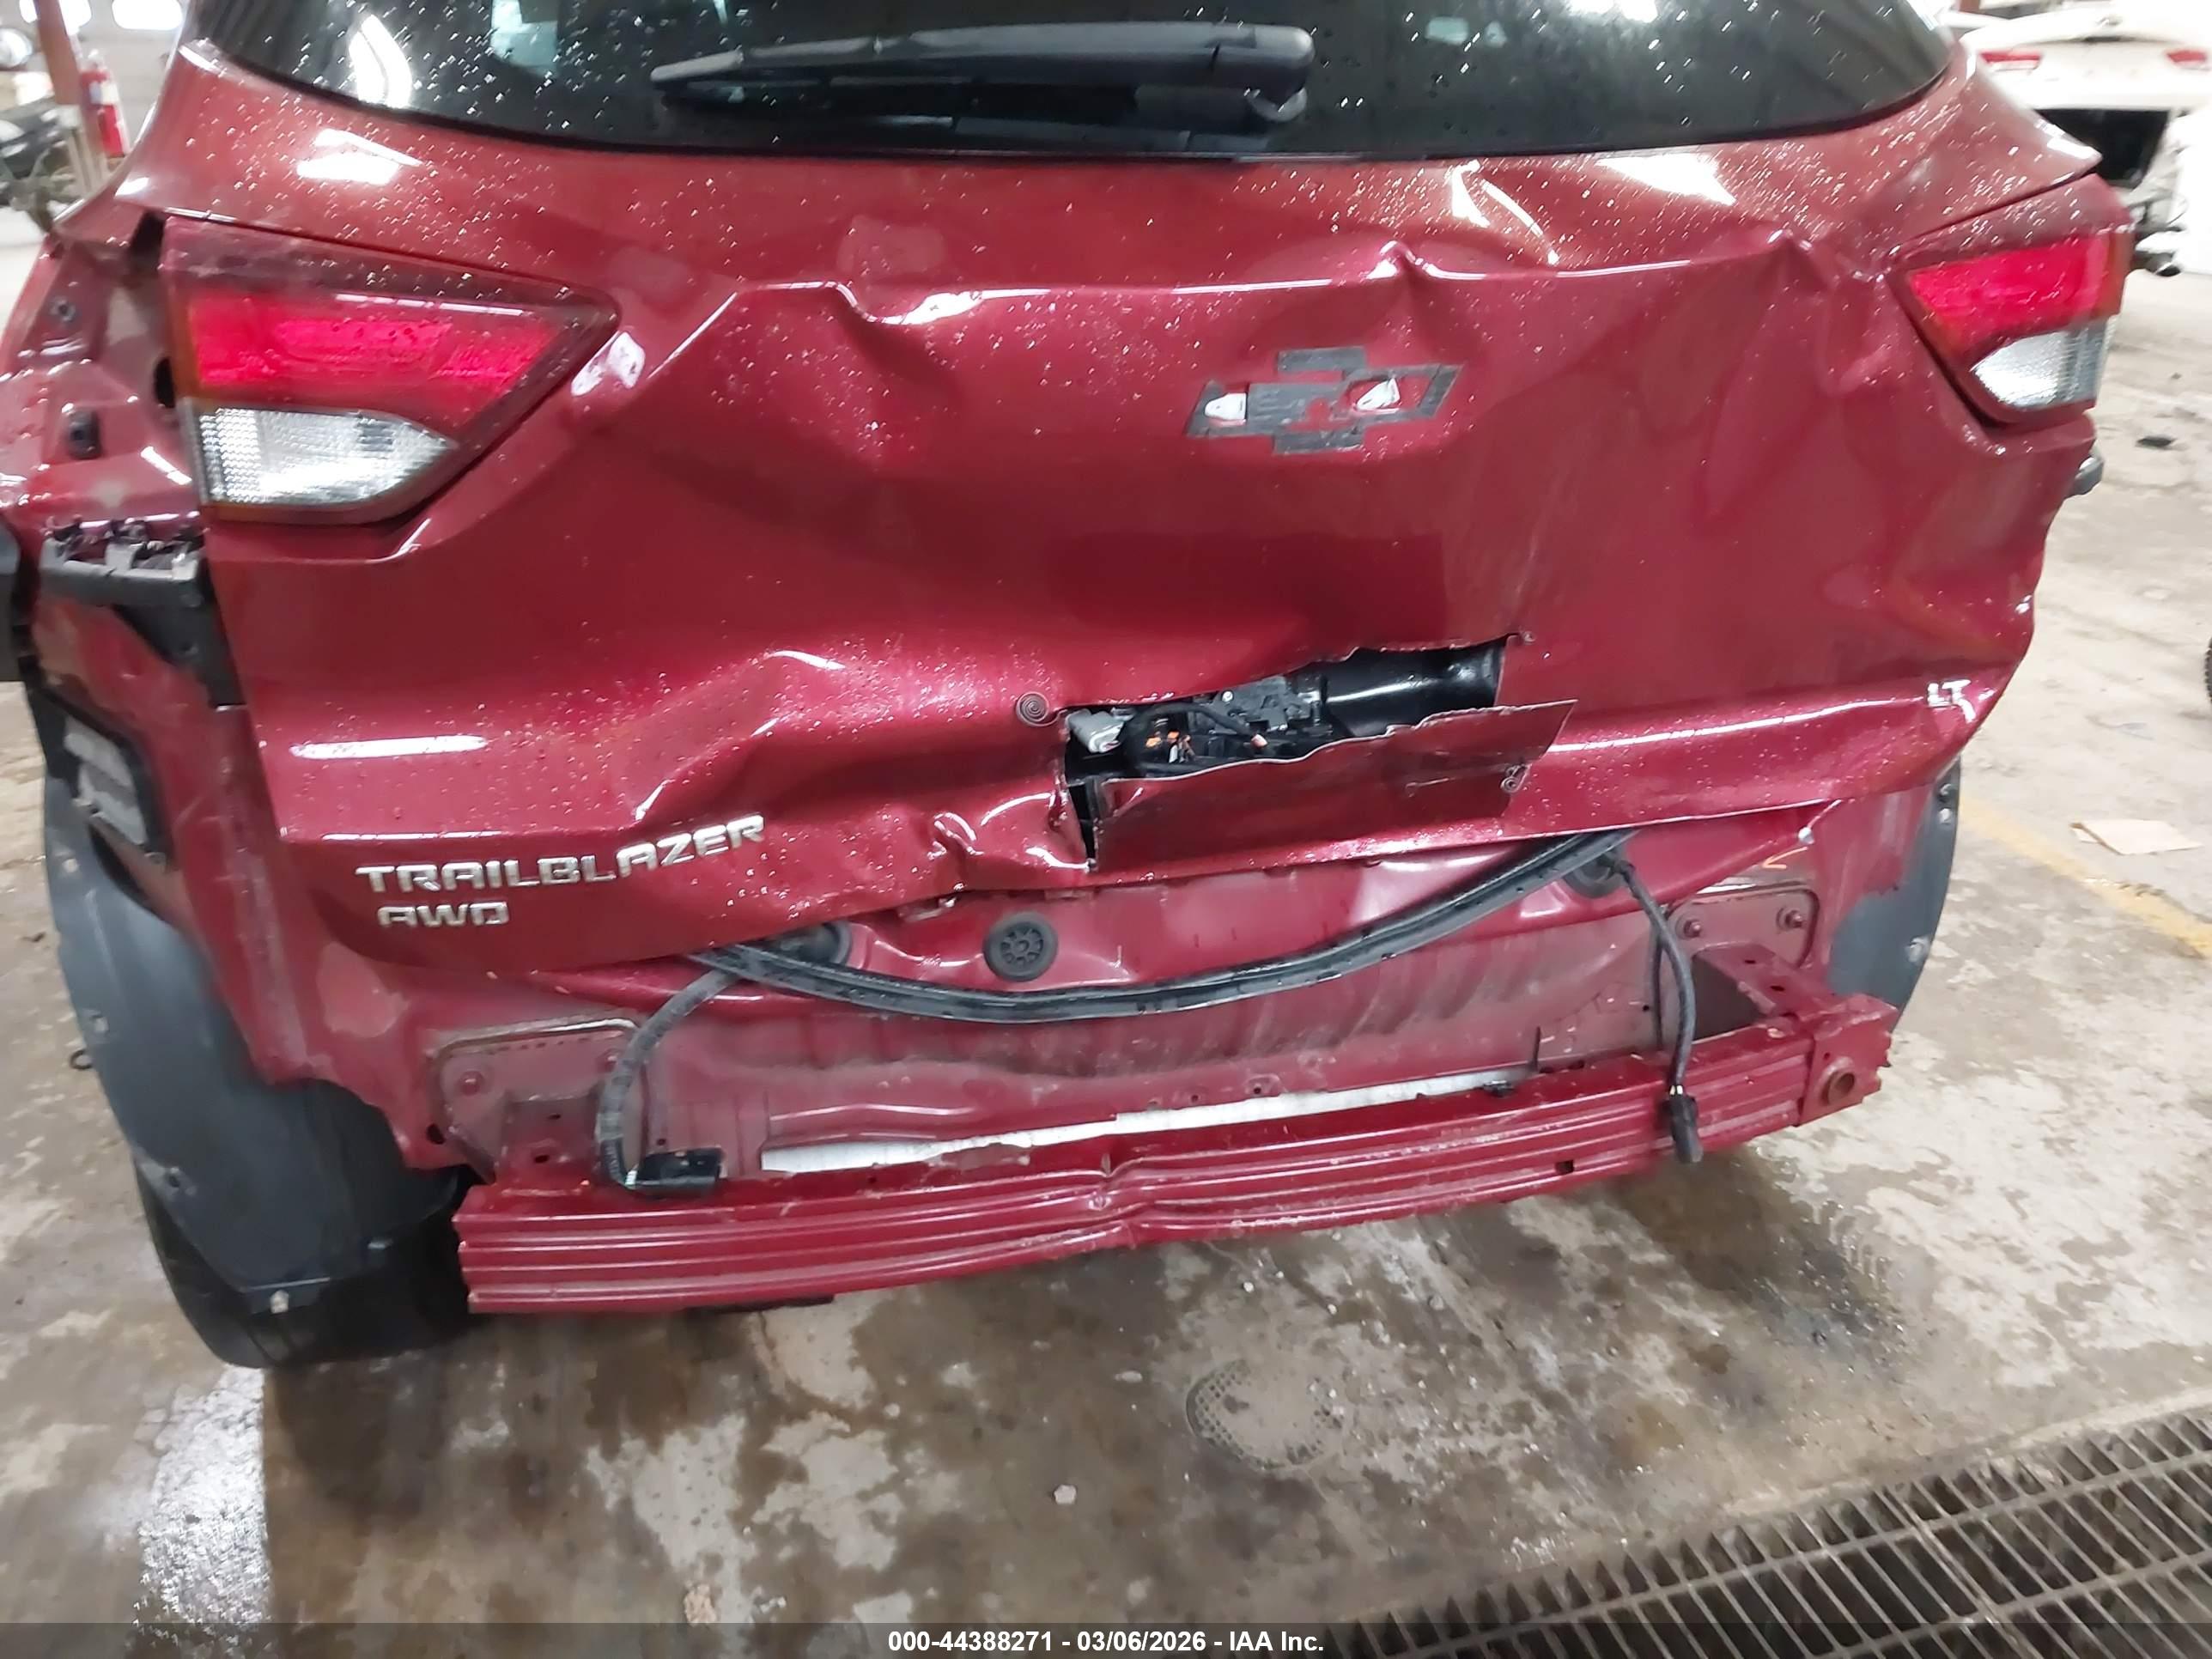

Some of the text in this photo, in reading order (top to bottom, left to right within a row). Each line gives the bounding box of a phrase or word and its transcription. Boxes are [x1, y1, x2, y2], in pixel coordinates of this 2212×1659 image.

[1926, 678, 1972, 707] LT
[355, 813, 765, 893] TRAILBLAZER
[376, 900, 510, 928] AWD
